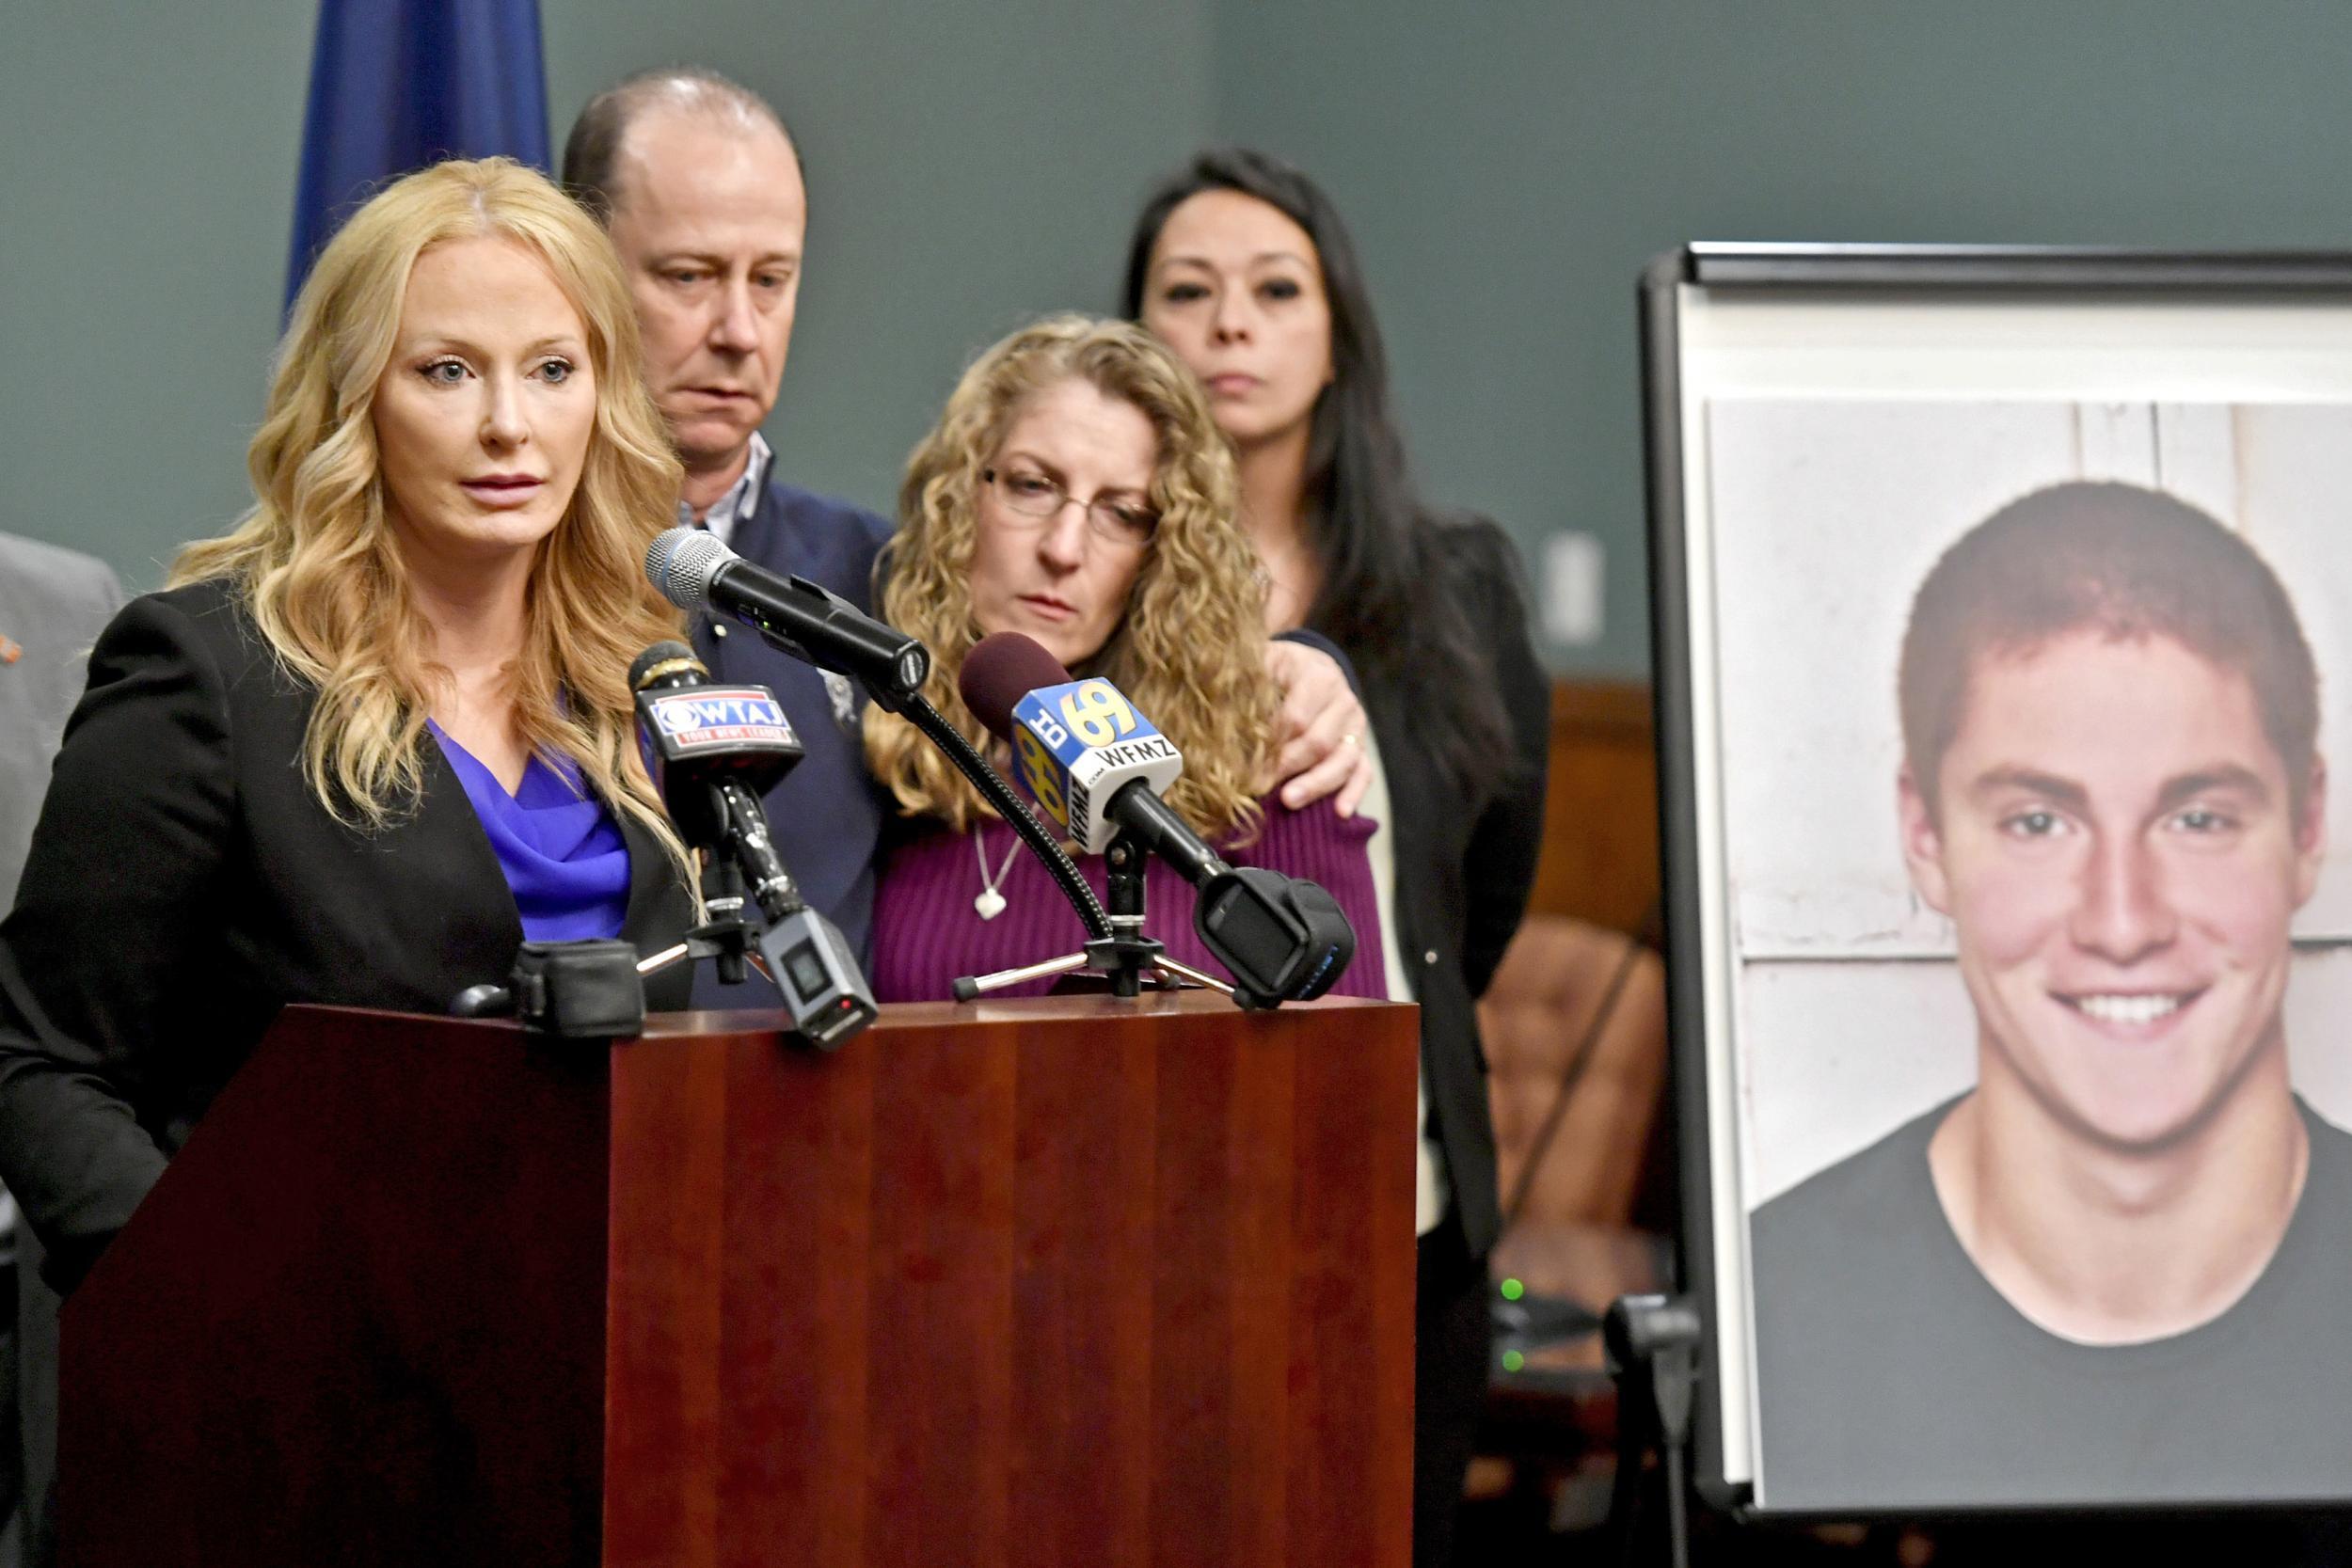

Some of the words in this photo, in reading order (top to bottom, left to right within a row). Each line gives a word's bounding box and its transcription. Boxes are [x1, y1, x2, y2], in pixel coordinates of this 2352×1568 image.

[694, 700, 783, 725] WTAJ
[1029, 709, 1068, 750] HD
[1059, 681, 1137, 748] 69
[1095, 739, 1176, 767] WFMZ
[1070, 775, 1089, 847] WFMZ
